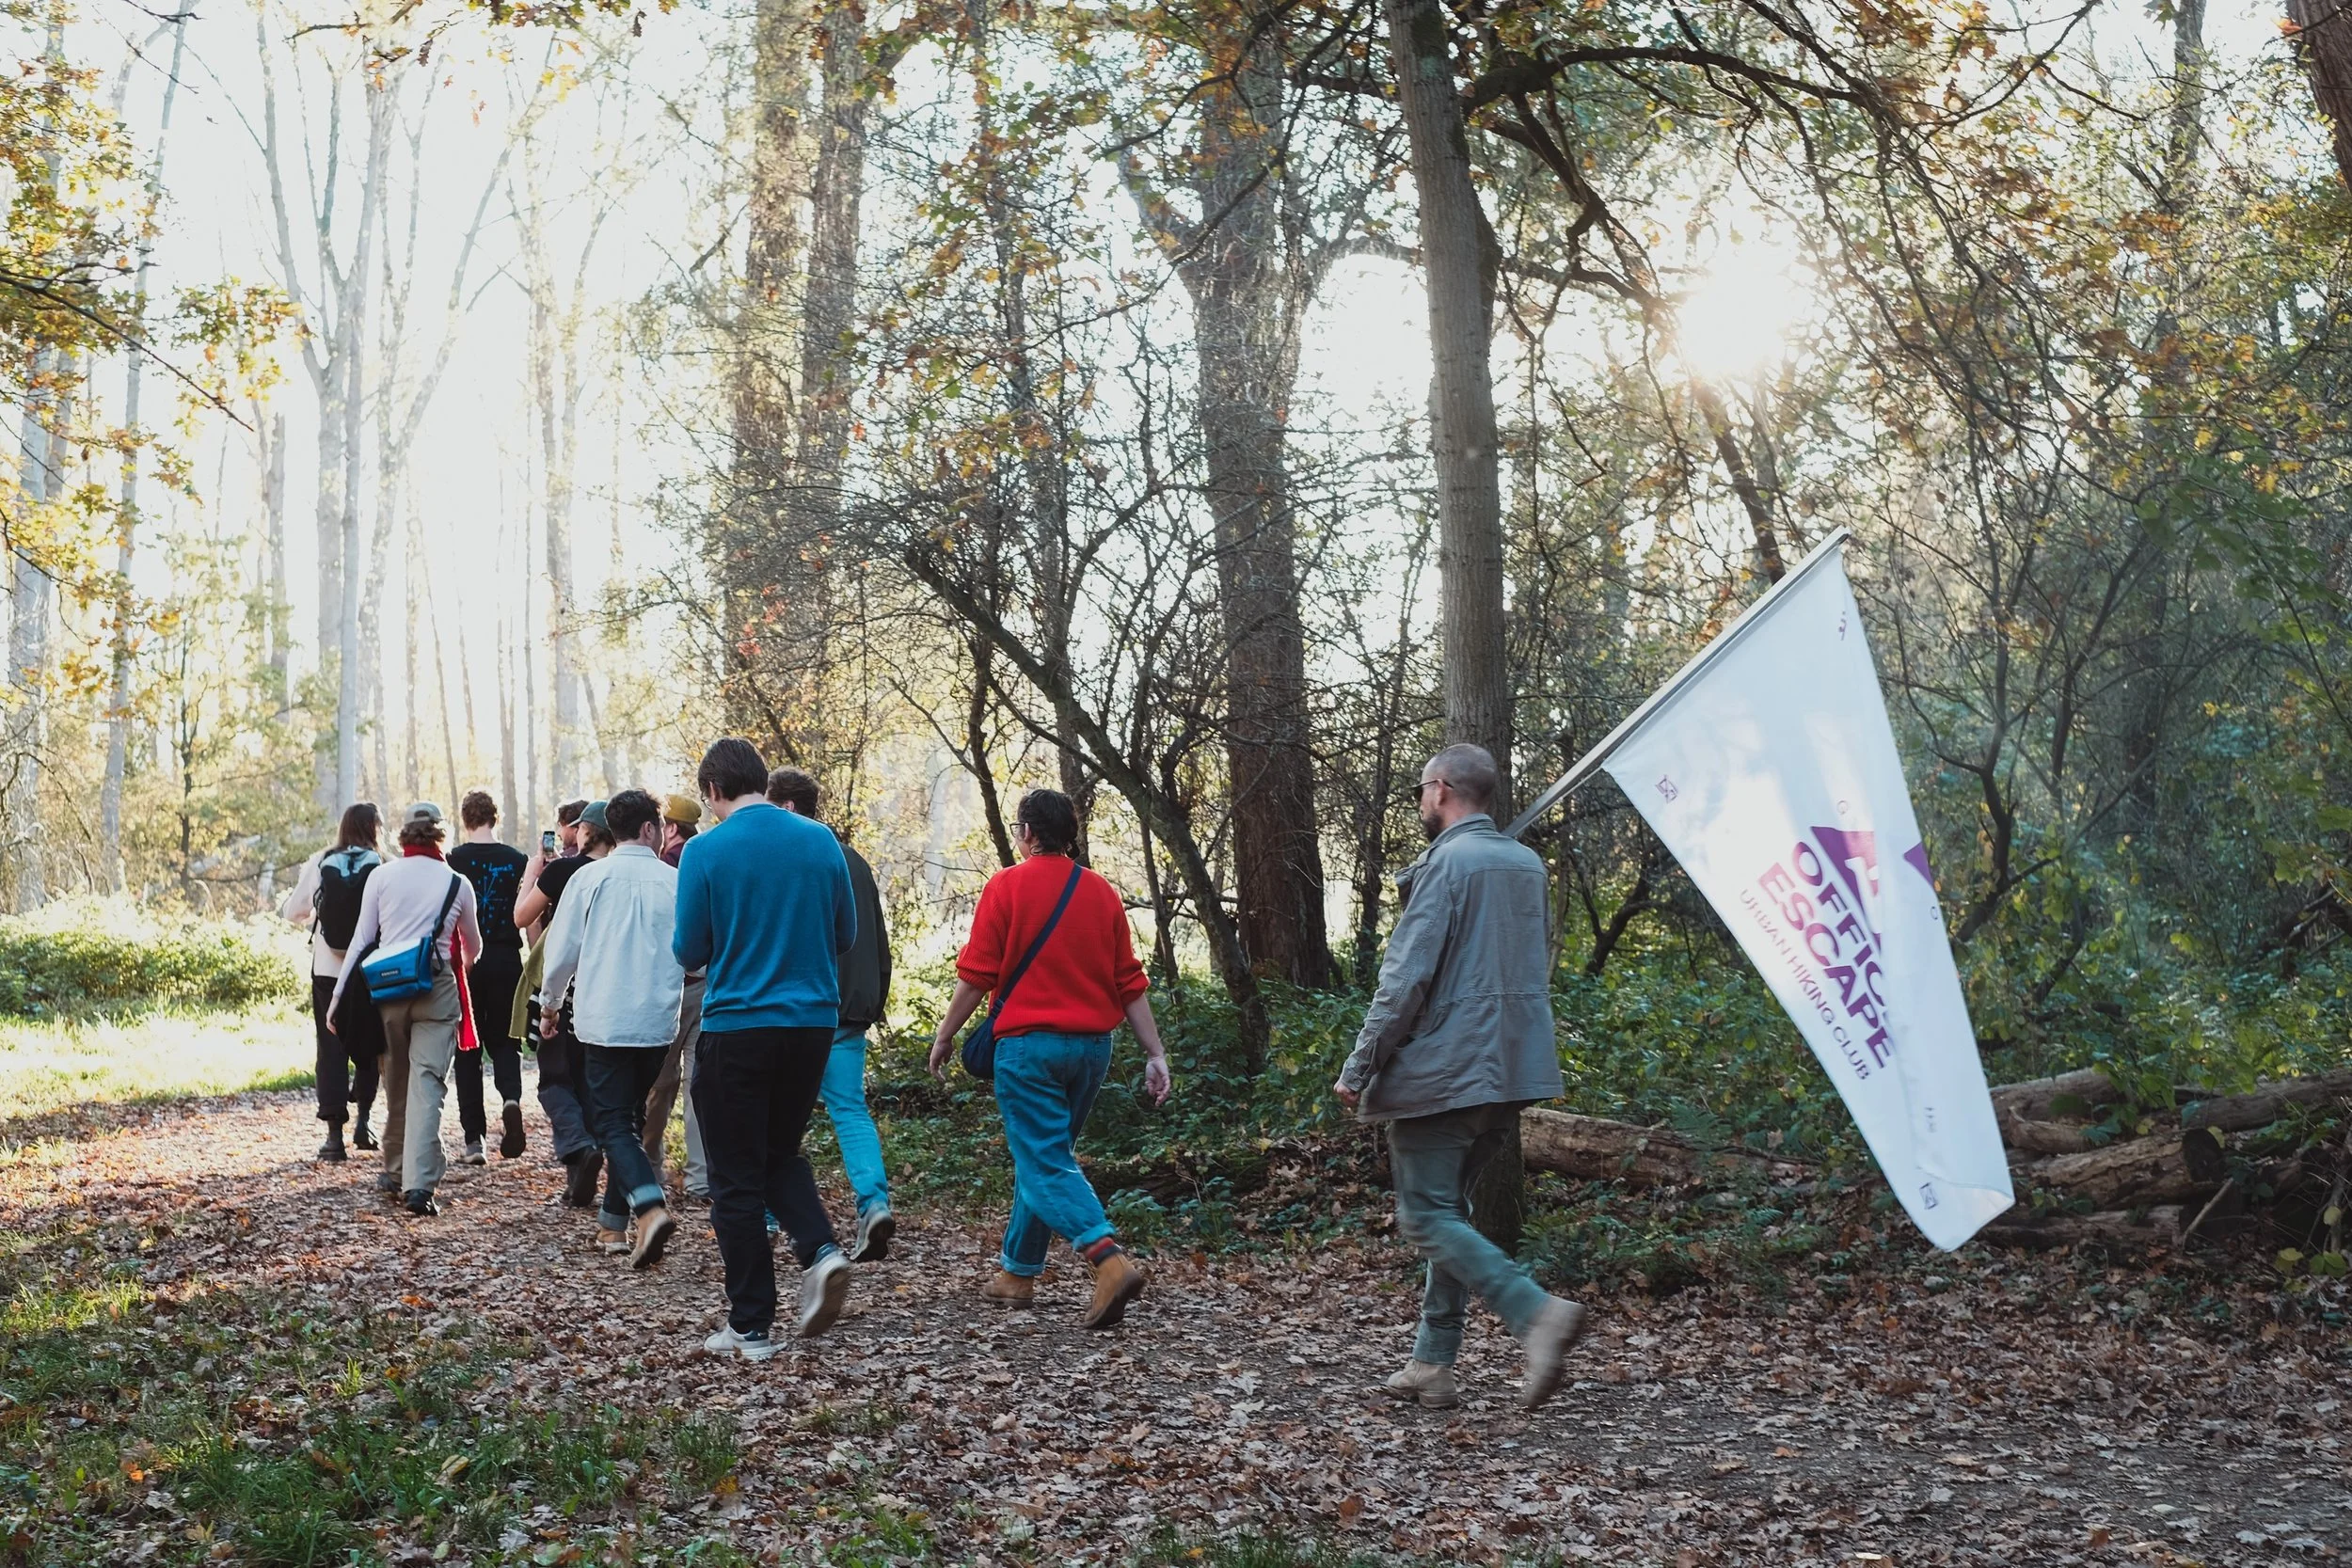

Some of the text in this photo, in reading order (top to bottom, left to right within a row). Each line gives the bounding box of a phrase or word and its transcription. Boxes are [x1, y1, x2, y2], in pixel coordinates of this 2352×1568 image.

[1740, 889, 1870, 1080] URBAN HIKING CLUB
[1757, 863, 1891, 1069] ESCAPE
[1791, 841, 1887, 1018] OFFIC
